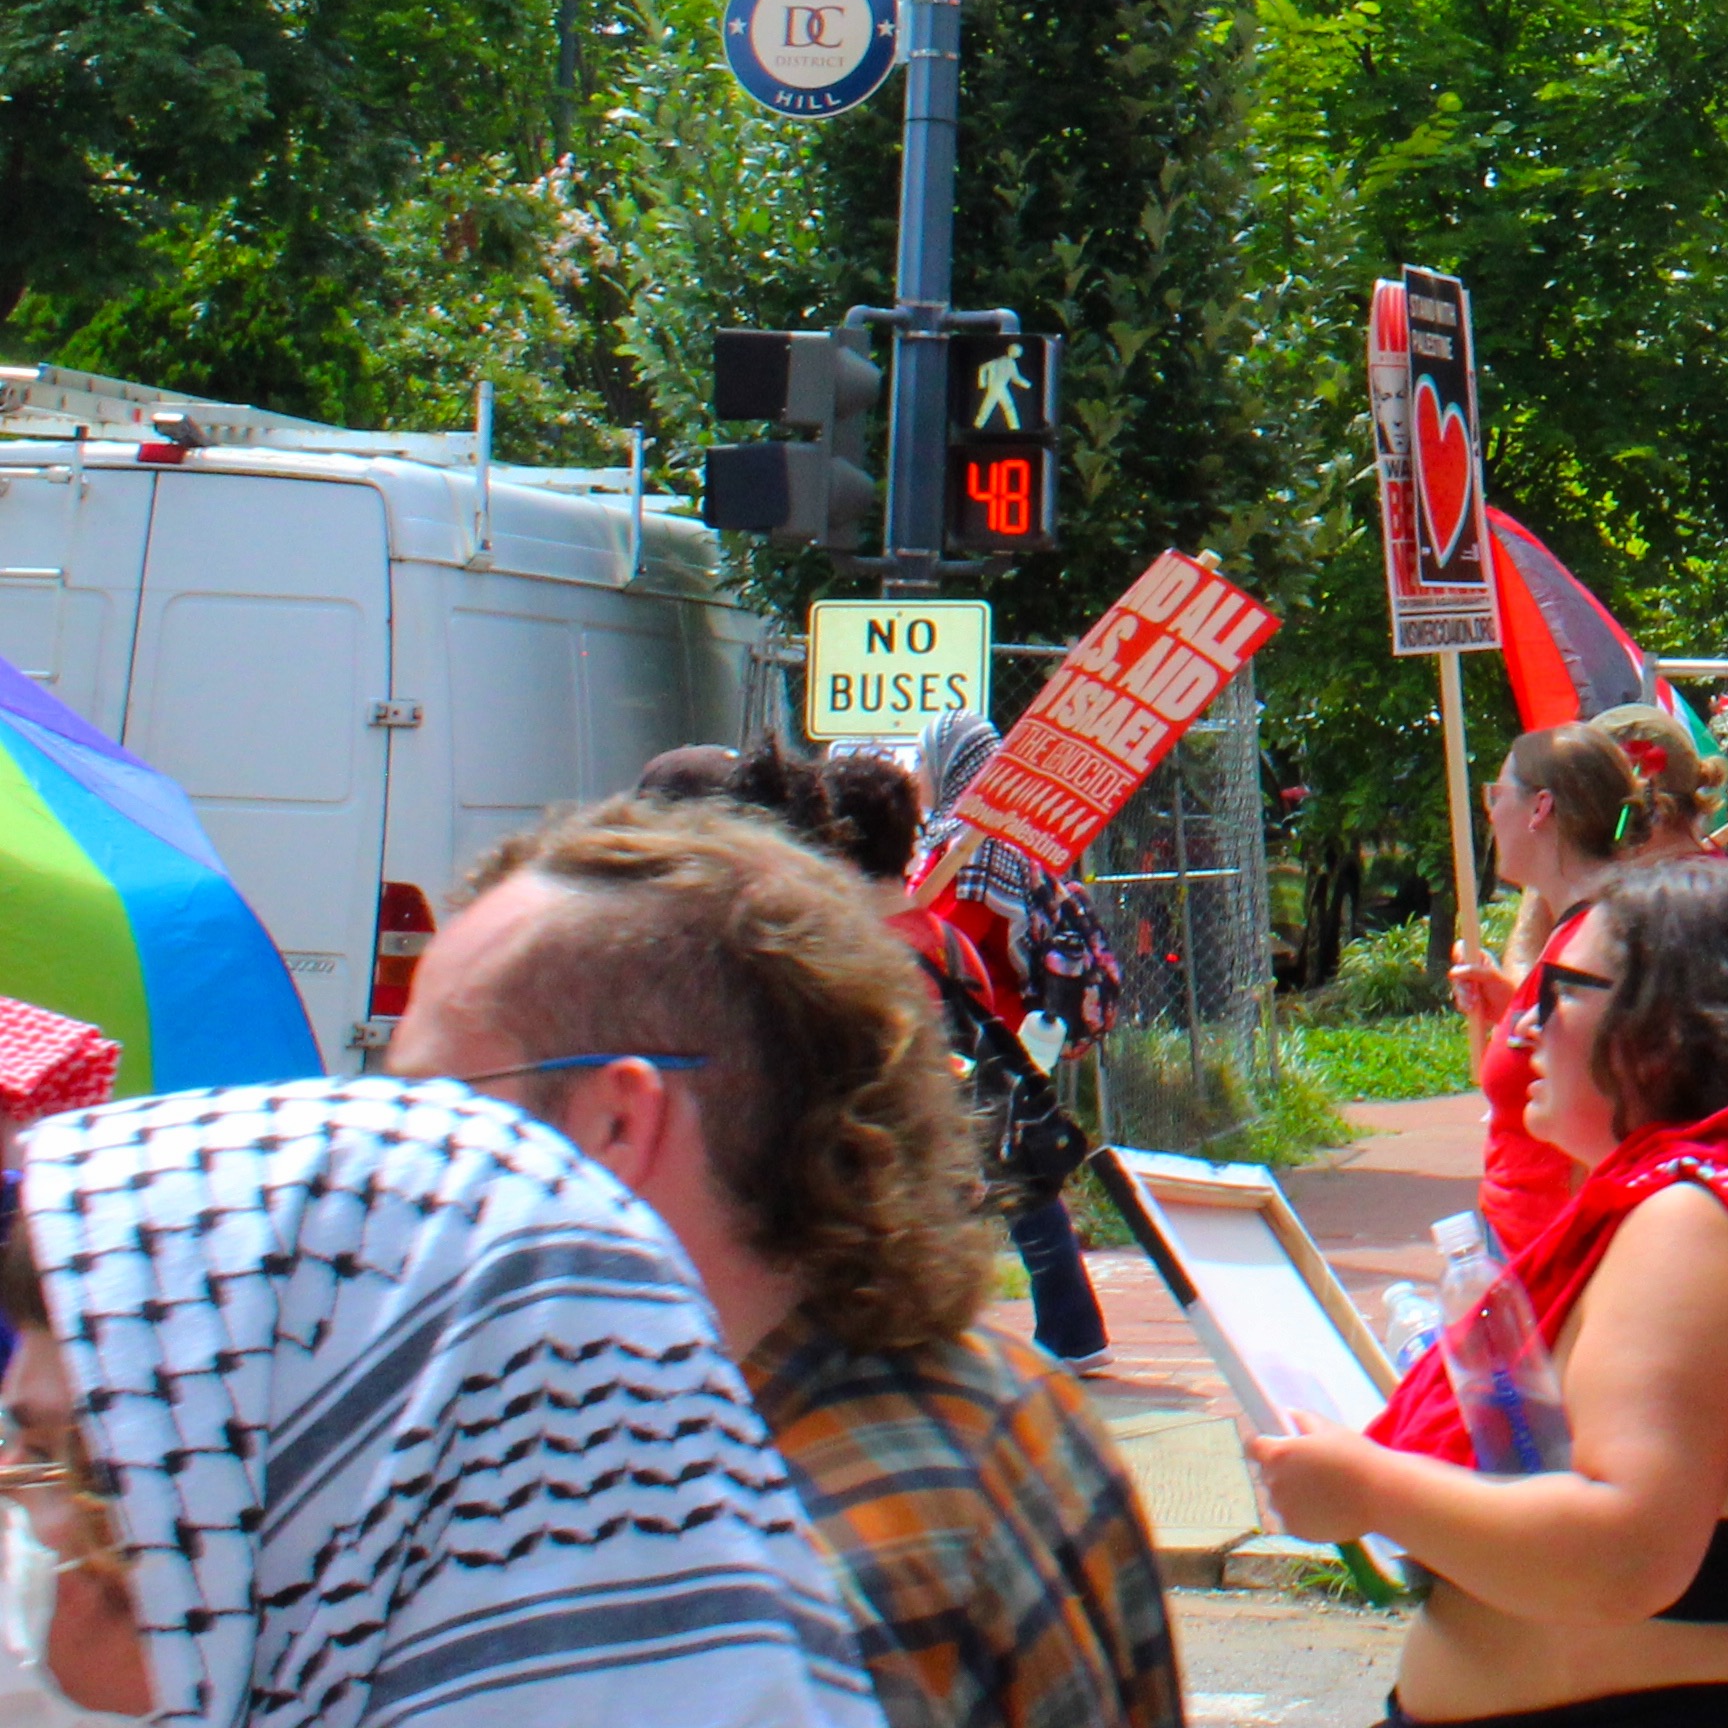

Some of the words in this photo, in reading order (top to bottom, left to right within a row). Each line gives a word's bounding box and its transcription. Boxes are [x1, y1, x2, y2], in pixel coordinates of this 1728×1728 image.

[782, 5, 845, 49] DC
[774, 55, 845, 68] DISTRICT
[775, 90, 842, 111] HILL
[968, 459, 1031, 535] 48
[1118, 554, 1200, 625] ND
[1168, 581, 1269, 672] ALL
[866, 617, 938, 655] NO
[829, 673, 970, 714] BUSES
[1112, 635, 1220, 722] AID
[1047, 674, 1170, 770] ISRAEL
